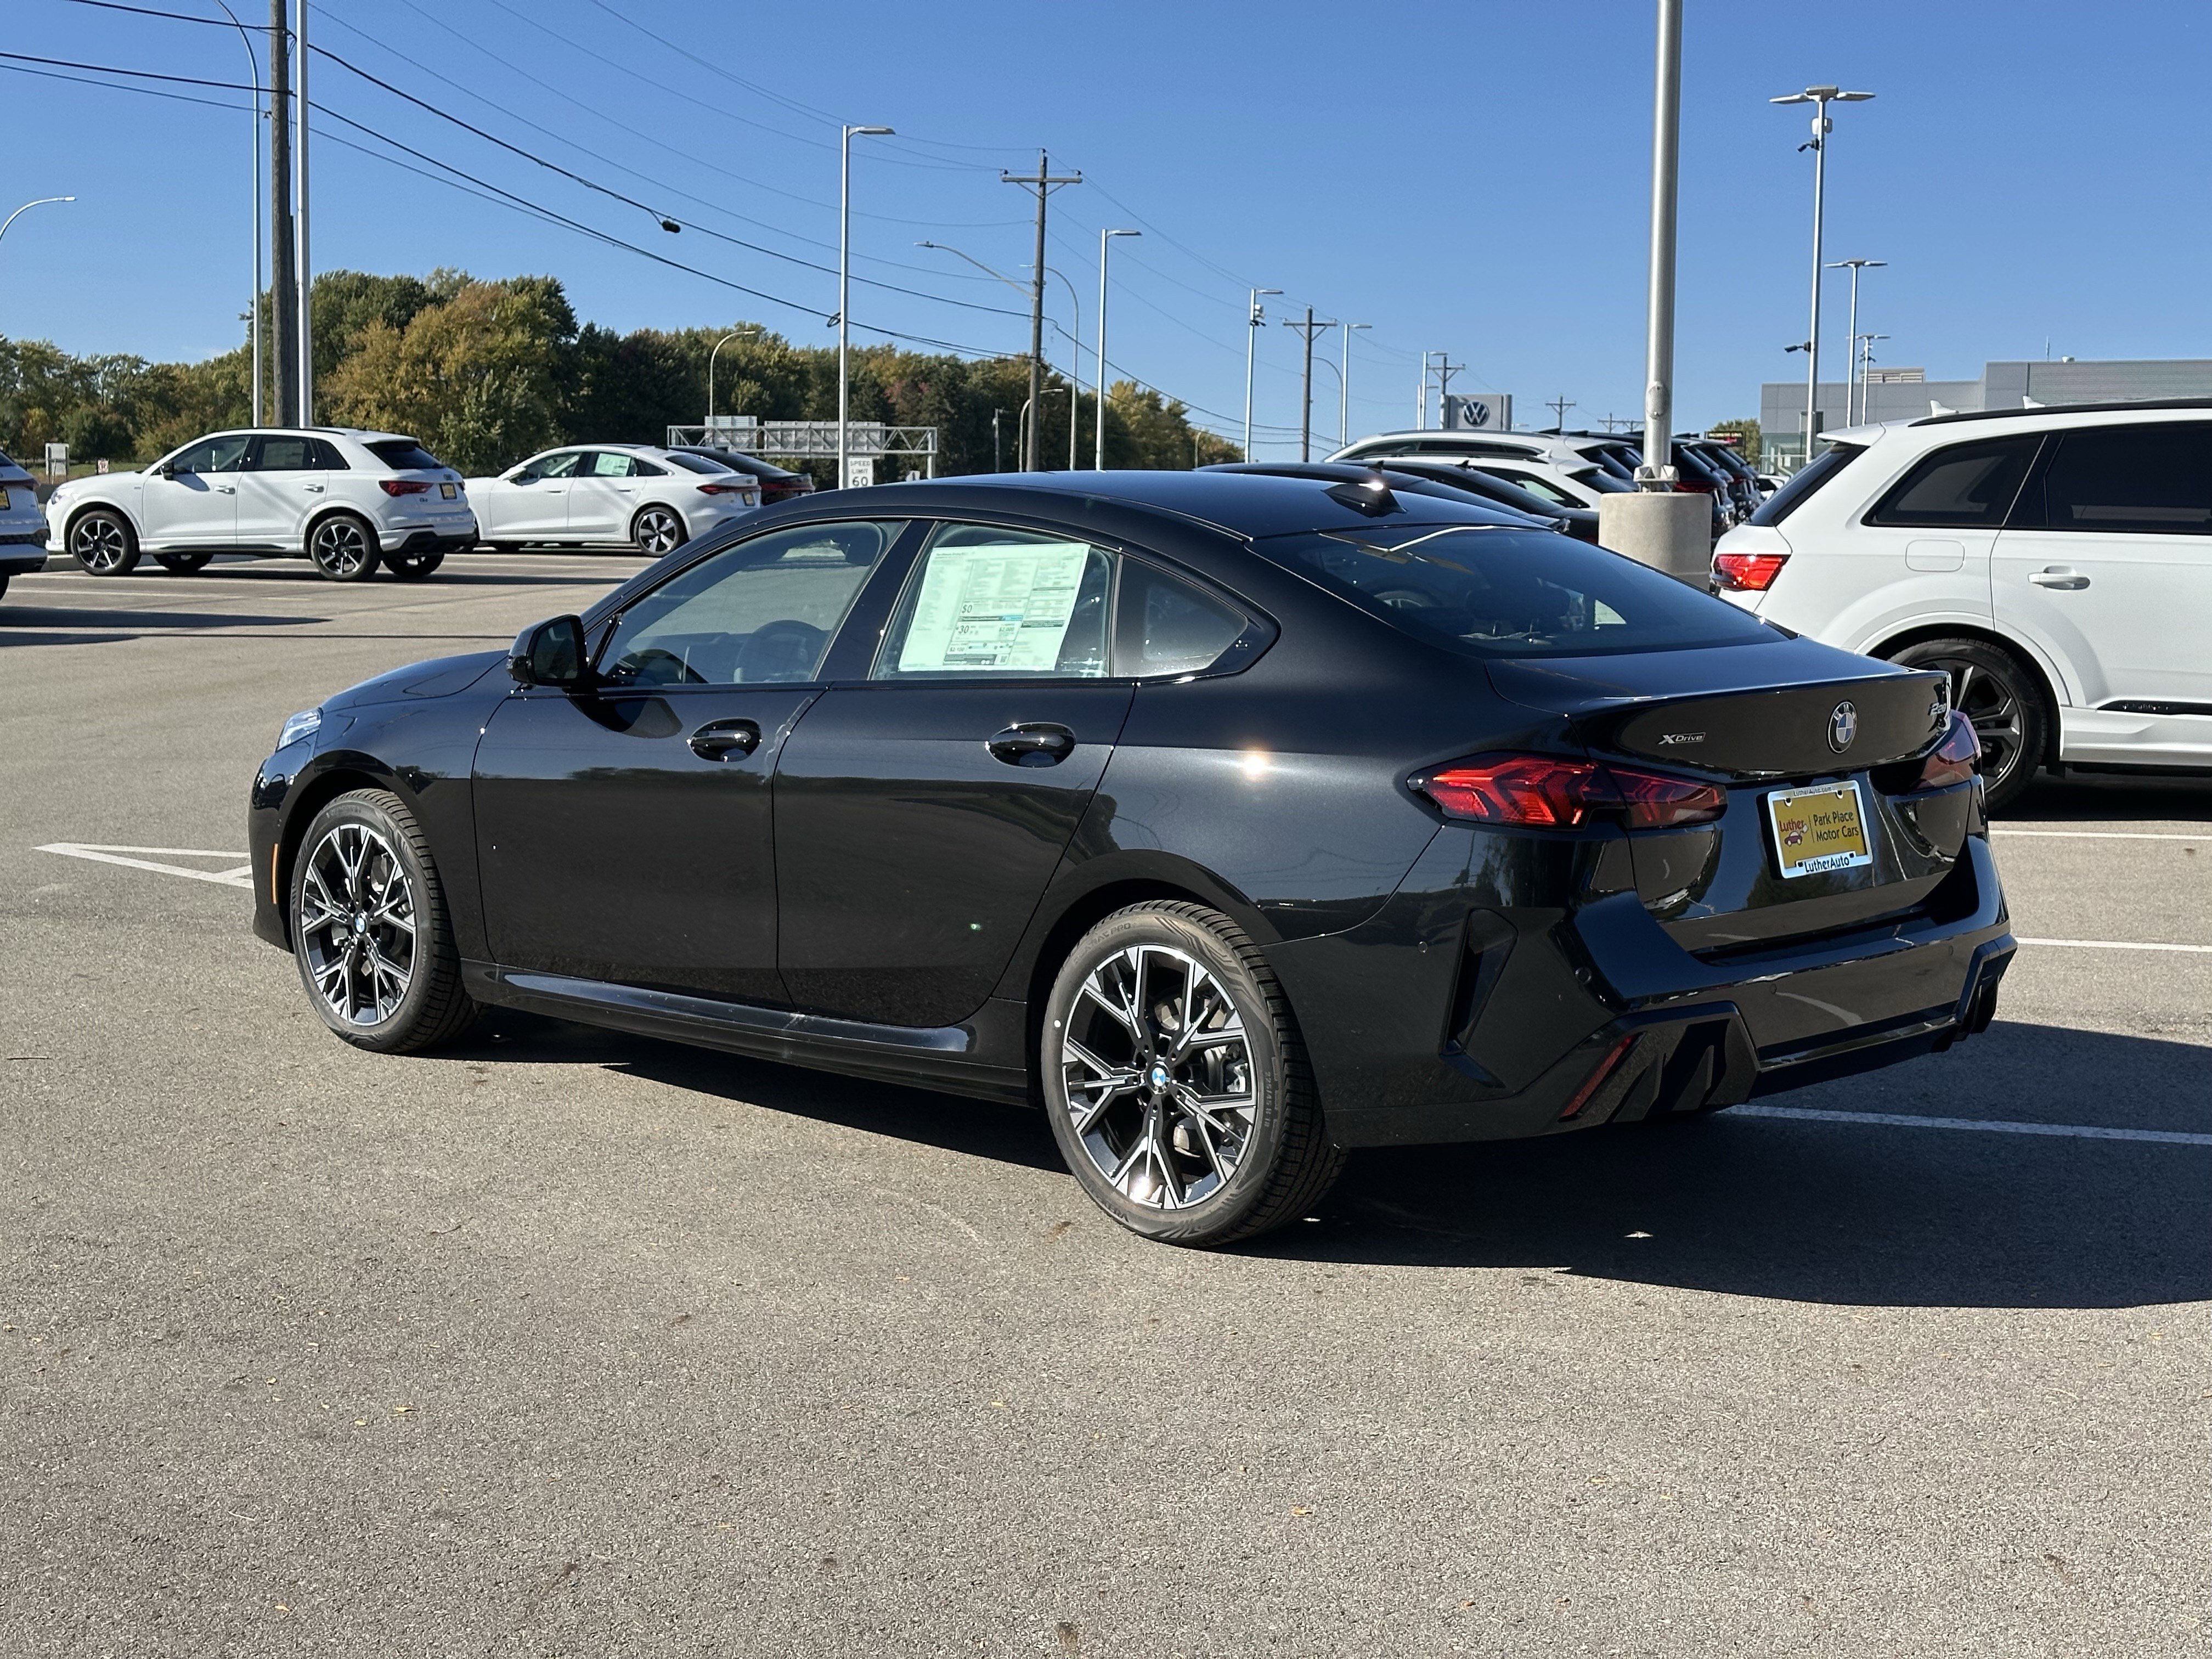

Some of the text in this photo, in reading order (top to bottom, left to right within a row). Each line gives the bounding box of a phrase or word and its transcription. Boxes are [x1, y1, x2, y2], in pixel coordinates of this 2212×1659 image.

[853, 476, 868, 487] 60
[958, 625, 969, 634] 30
[1779, 818, 1804, 832] Luther
[1813, 810, 1854, 826] Park Place
[1816, 825, 1859, 842] Motor Cars
[1804, 856, 1850, 872] LutherAuto
[1110, 922, 1131, 935] PRO
